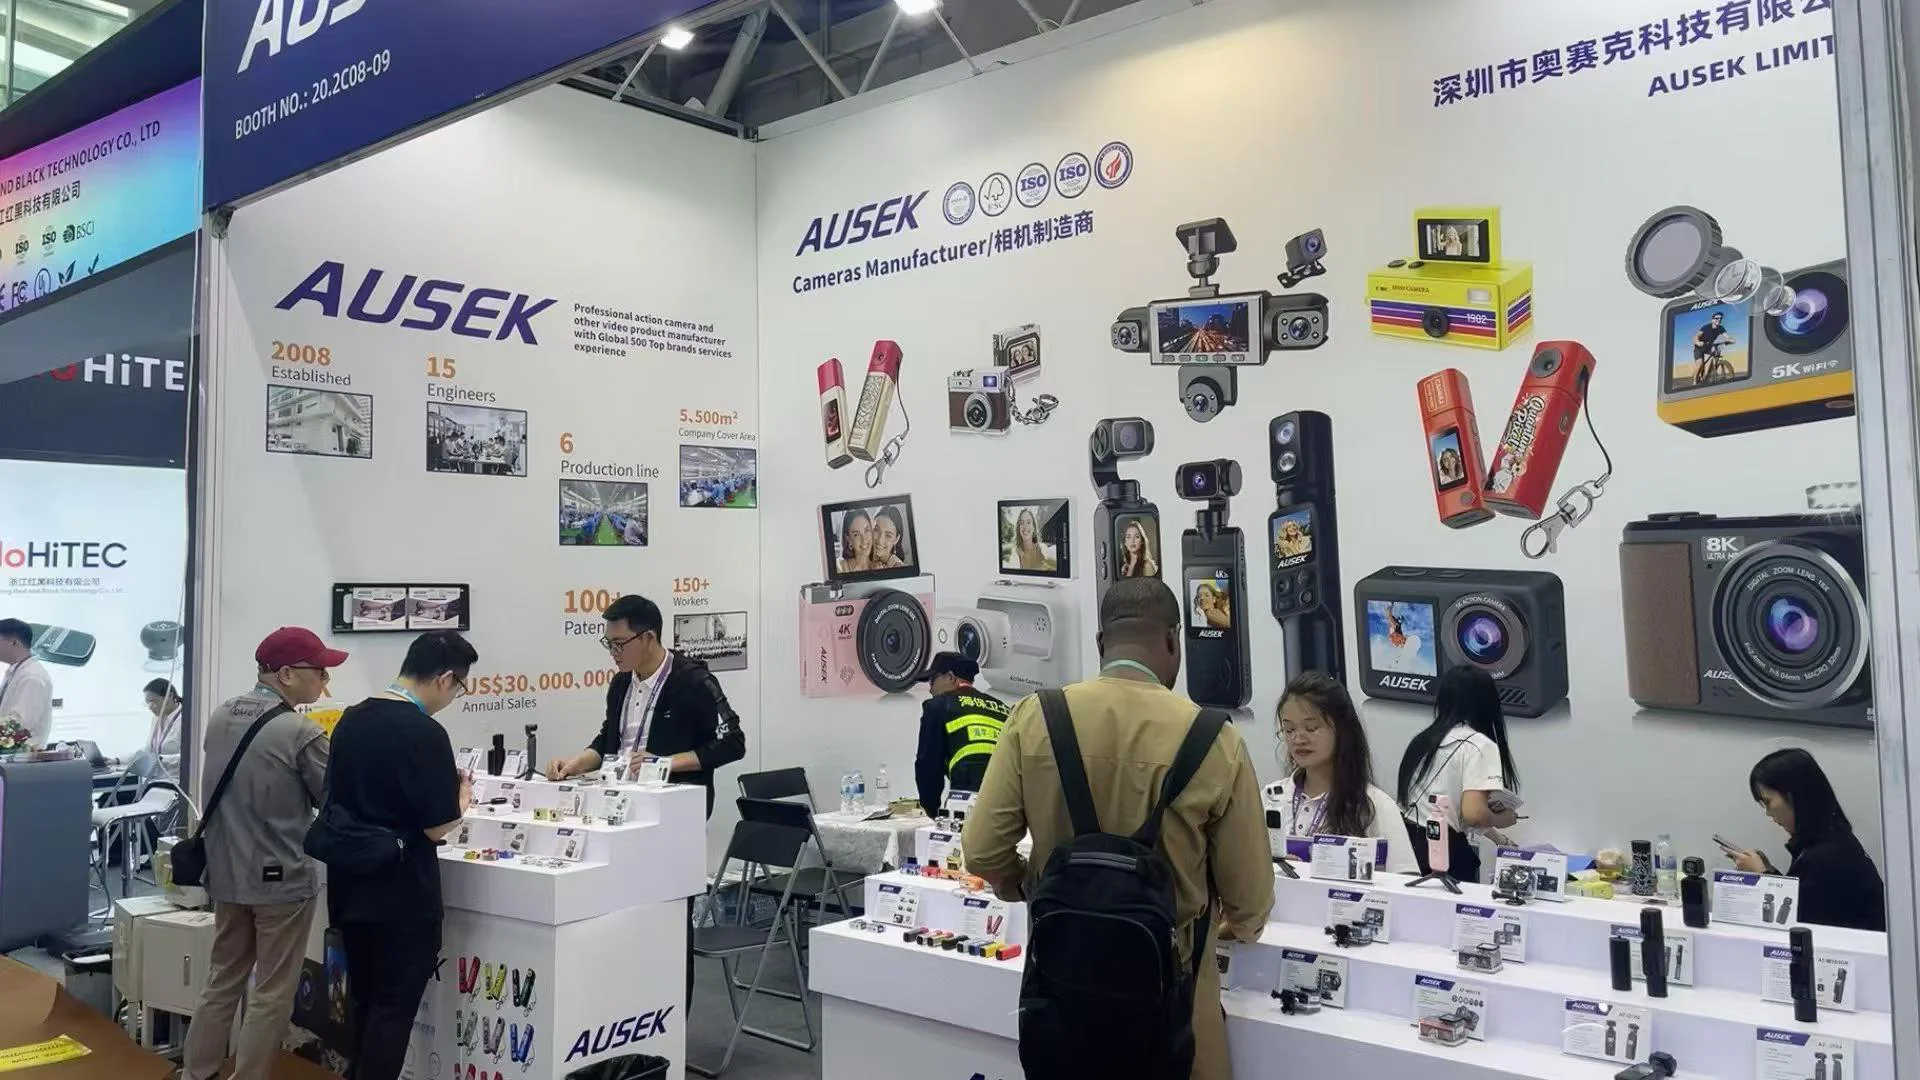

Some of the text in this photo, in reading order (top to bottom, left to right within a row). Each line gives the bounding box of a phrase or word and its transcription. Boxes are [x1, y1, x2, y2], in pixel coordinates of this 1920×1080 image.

[1647, 56, 1747, 97] AUSEK
[235, 49, 390, 140] BOOTH NO.: 20.2C08-09
[16, 167, 45, 191] BLACK
[47, 138, 114, 178] TECHNOLOGY
[141, 120, 160, 141] LTD
[1020, 163, 1087, 192] ISO ISO
[795, 190, 930, 257] AUSEK
[15, 221, 95, 254] ISO ISO BSCI
[793, 264, 861, 294] Cameras
[274, 260, 558, 346] AUSEK
[574, 303, 714, 333] Professional action camera and
[574, 316, 726, 346] other video product manufacturer
[271, 340, 331, 366] 2008
[574, 329, 732, 359] with Global 500 Top brands services
[574, 342, 626, 358] experience
[272, 366, 351, 386] Established
[427, 356, 456, 379] 15
[1772, 362, 1801, 379] 5K
[427, 383, 496, 402] Engineers
[559, 432, 574, 454] 6
[678, 427, 756, 442] Company Cover Area
[561, 459, 659, 478] Production line
[1706, 537, 1740, 552] 8K
[1277, 554, 1308, 569] AUSEK
[673, 577, 710, 593] 150+
[1748, 572, 1770, 592] DIGITAL
[1773, 566, 1795, 575] ZOOM
[673, 595, 708, 607] Workers
[839, 623, 851, 634] 4K
[1199, 630, 1224, 638] AUSEK
[820, 646, 828, 684] AUSEK
[1379, 674, 1431, 692] AUSEK
[462, 697, 537, 713] Annual Sales
[1420, 977, 1441, 986] AUSEK
[564, 1005, 675, 1062] AUSEK
[1764, 1032, 1792, 1041] AUSEK
